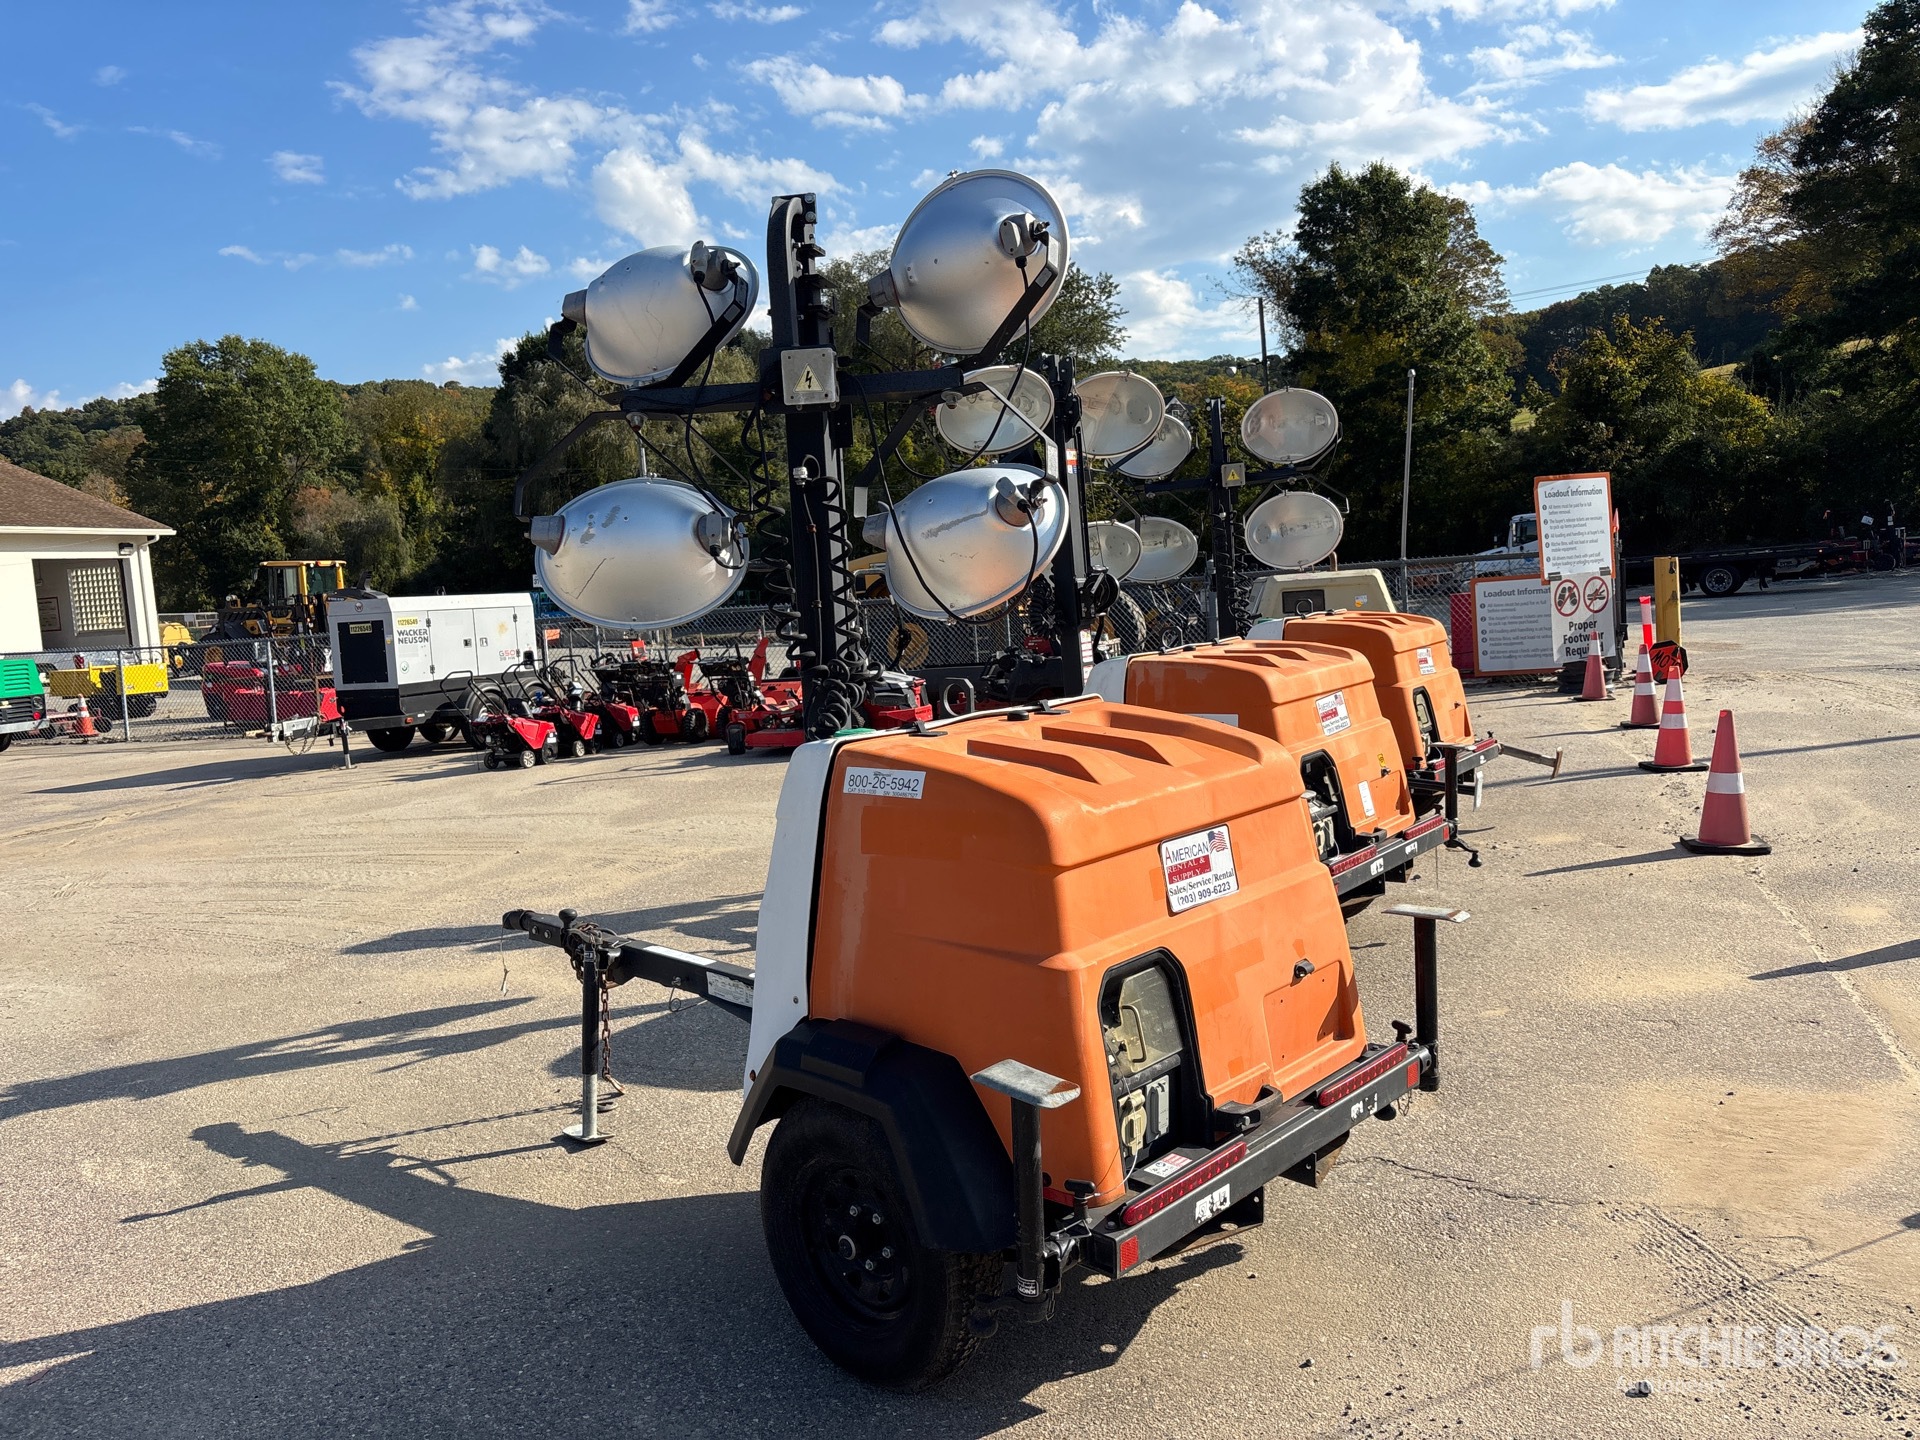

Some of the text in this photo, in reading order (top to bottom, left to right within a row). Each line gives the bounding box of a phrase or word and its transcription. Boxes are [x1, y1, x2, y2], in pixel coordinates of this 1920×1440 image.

[1545, 488, 1602, 498] Loadout Information
[1483, 587, 1550, 598] Loadout Informat
[396, 628, 428, 636] WACKER
[1568, 620, 1597, 632] Proper
[398, 636, 428, 644] NEUSON
[1563, 632, 1604, 644] Footwr
[1566, 641, 1604, 658] Requid
[848, 774, 919, 792] 800-26-5942
[1165, 841, 1209, 866] AMERICAN
[1167, 859, 1198, 874] RENTAL
[1169, 868, 1234, 896] Sales/Service/Rental
[1177, 881, 1231, 906] (203) 909-6223
